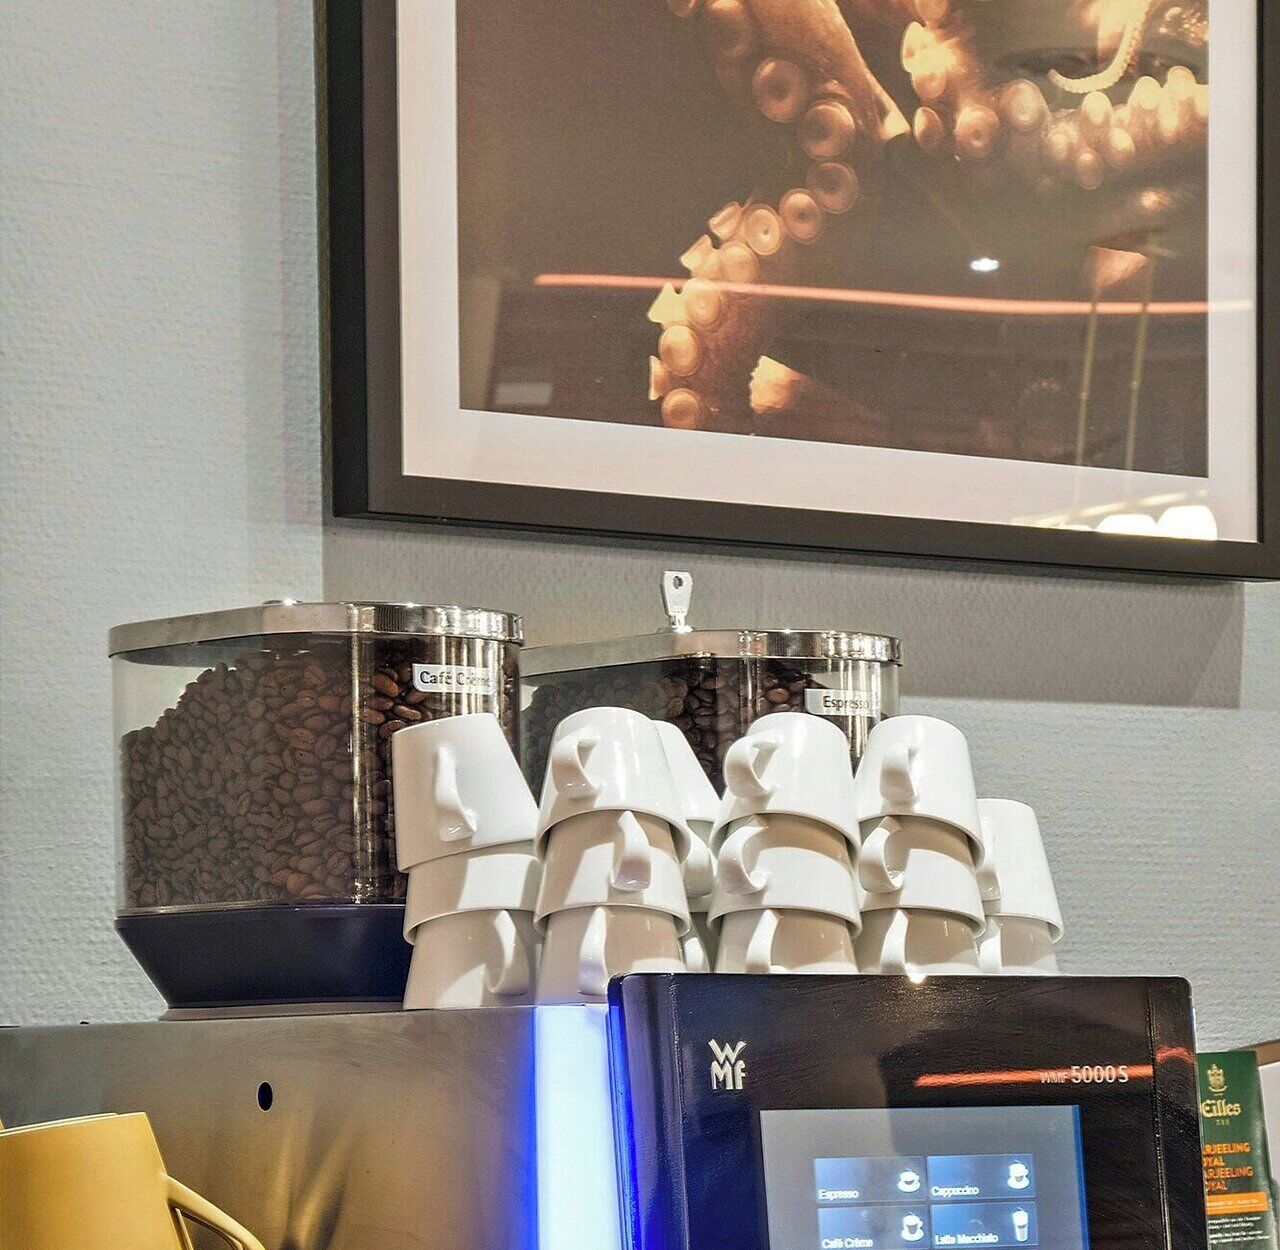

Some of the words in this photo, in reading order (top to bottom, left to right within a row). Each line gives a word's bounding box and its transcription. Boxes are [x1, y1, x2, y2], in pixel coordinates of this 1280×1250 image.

[420, 671, 452, 685] Café
[823, 695, 869, 711] Espresso
[708, 1039, 747, 1089] WMF
[1201, 1099, 1242, 1117] Eilles
[819, 1189, 859, 1200] Espresso
[931, 1186, 979, 1198] Cappuccino
[821, 1239, 844, 1249] Café
[935, 1234, 956, 1245] Latte
[957, 1233, 999, 1244] Macchiato
